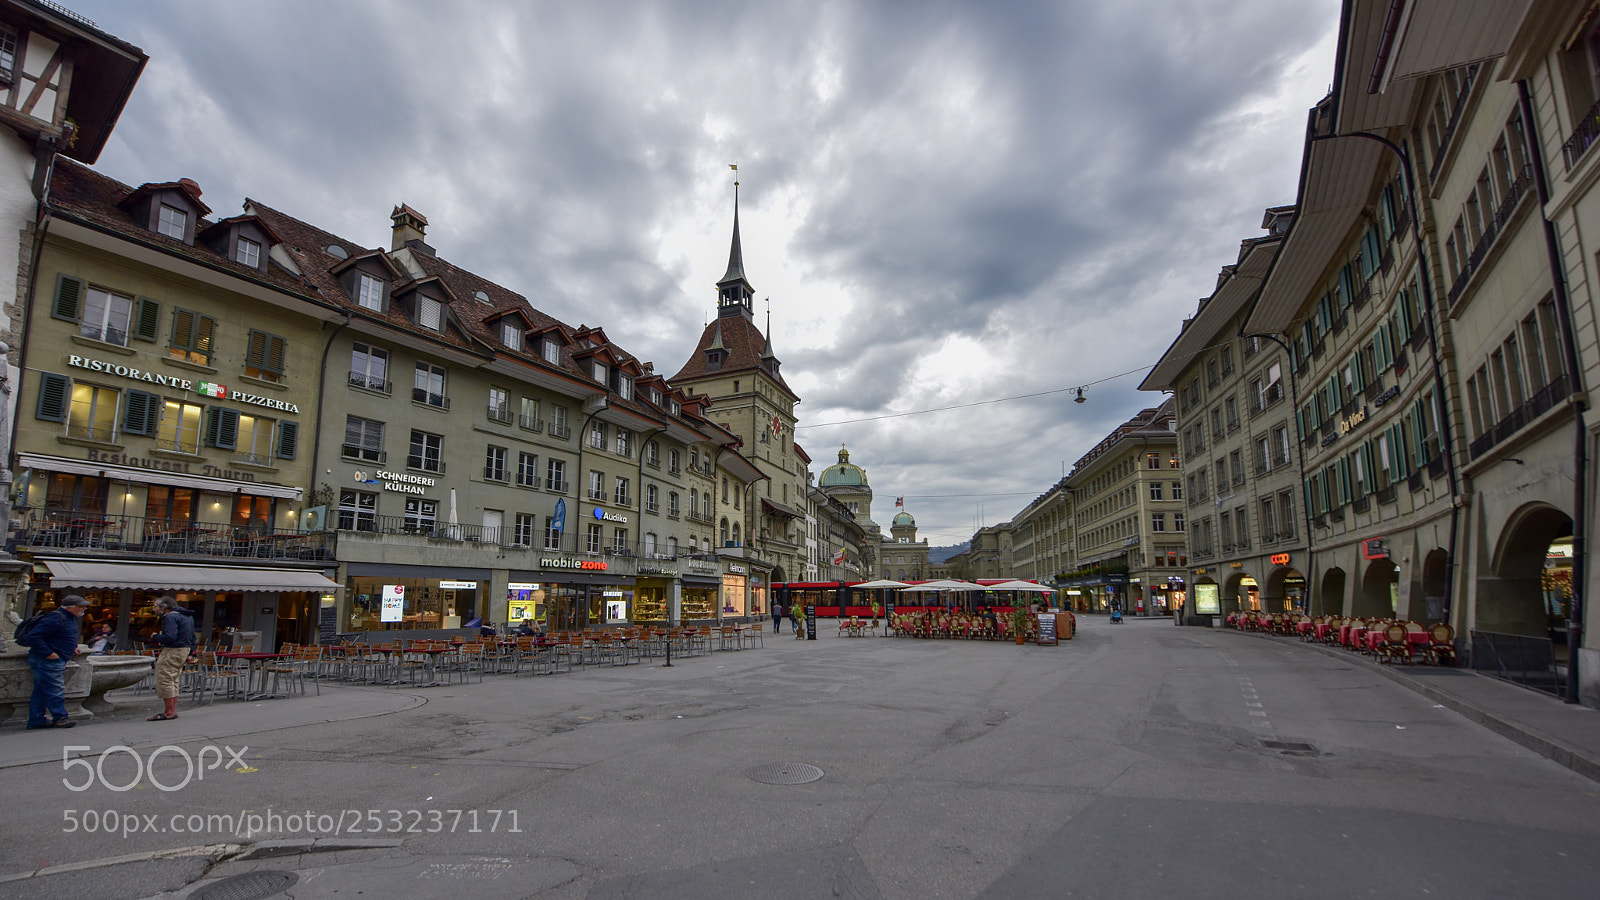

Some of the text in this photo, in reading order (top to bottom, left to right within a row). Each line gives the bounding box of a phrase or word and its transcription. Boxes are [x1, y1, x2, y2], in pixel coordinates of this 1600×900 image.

[67, 354, 192, 390] RISTORANTE
[231, 390, 300, 413] PIZZERIA
[87, 448, 190, 474] Restaurant
[376, 470, 435, 487] SCHNEIDEREI
[384, 481, 425, 495] KÜLHAN
[602, 511, 628, 523] Audika
[541, 558, 608, 571] mobilezone
[1271, 553, 1290, 566] coop
